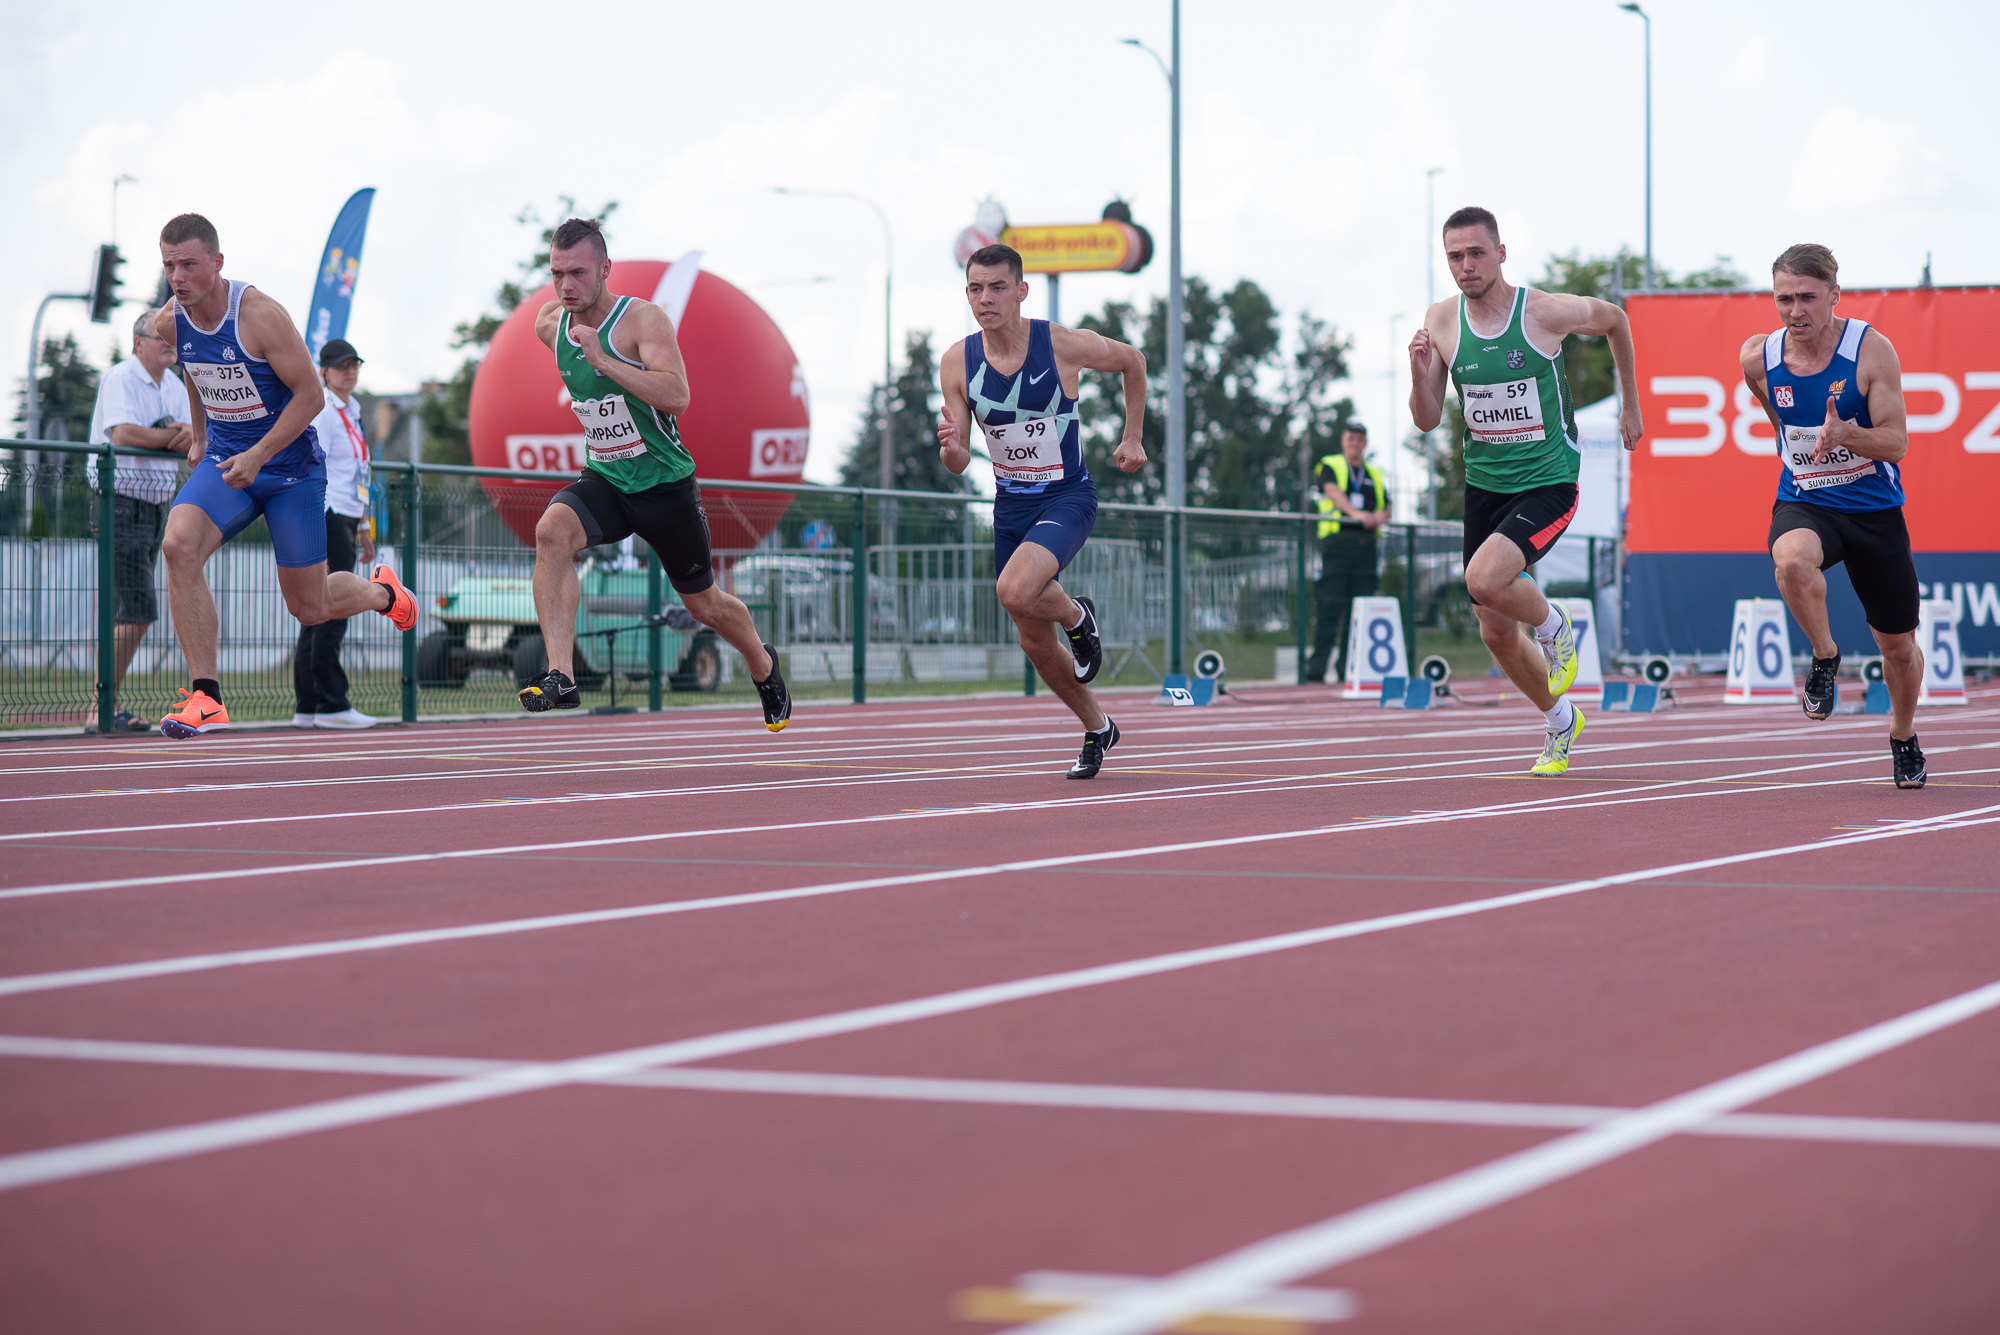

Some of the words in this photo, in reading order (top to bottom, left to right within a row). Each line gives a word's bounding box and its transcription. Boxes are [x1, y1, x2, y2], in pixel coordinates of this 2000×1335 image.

[217, 366, 244, 380] 375
[197, 385, 256, 402] WYKROTA
[1507, 382, 1528, 399] 59
[239, 412, 255, 420] 2021
[598, 400, 615, 417] 67
[1472, 406, 1533, 424] CHMIEL
[1024, 422, 1046, 438] 99
[1482, 434, 1514, 443] SUWAŁKI
[1515, 433, 1533, 442] 2021
[619, 450, 635, 459] 2021
[1004, 446, 1039, 461] ŻOK
[1003, 471, 1033, 480] SUWAŁKI
[1034, 472, 1052, 480] 2021
[1808, 476, 1844, 488] SUWAŁKI
[1844, 472, 1863, 483] 2021
[1918, 581, 2000, 627] UW
[1368, 617, 1396, 674] 8
[1571, 620, 1588, 657] 7
[1734, 621, 1746, 678] 6
[1756, 621, 1783, 679] 6
[1932, 621, 1954, 680] 5
